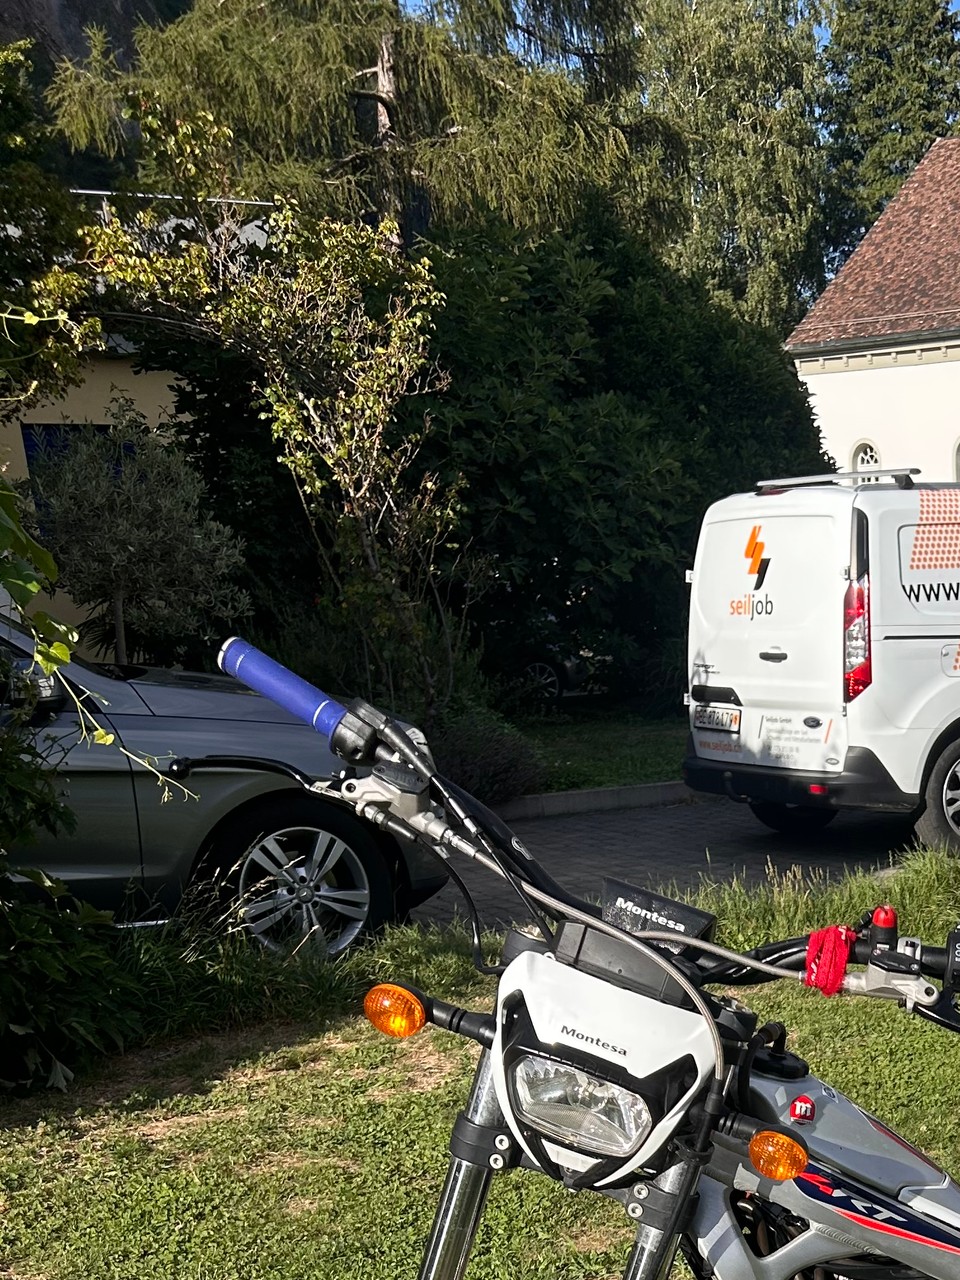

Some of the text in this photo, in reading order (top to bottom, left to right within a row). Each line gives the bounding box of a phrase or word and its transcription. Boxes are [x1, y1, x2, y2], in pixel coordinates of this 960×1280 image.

[730, 593, 774, 621] seiljob
[615, 896, 686, 933] Montesa
[560, 1025, 628, 1057] Montesa
